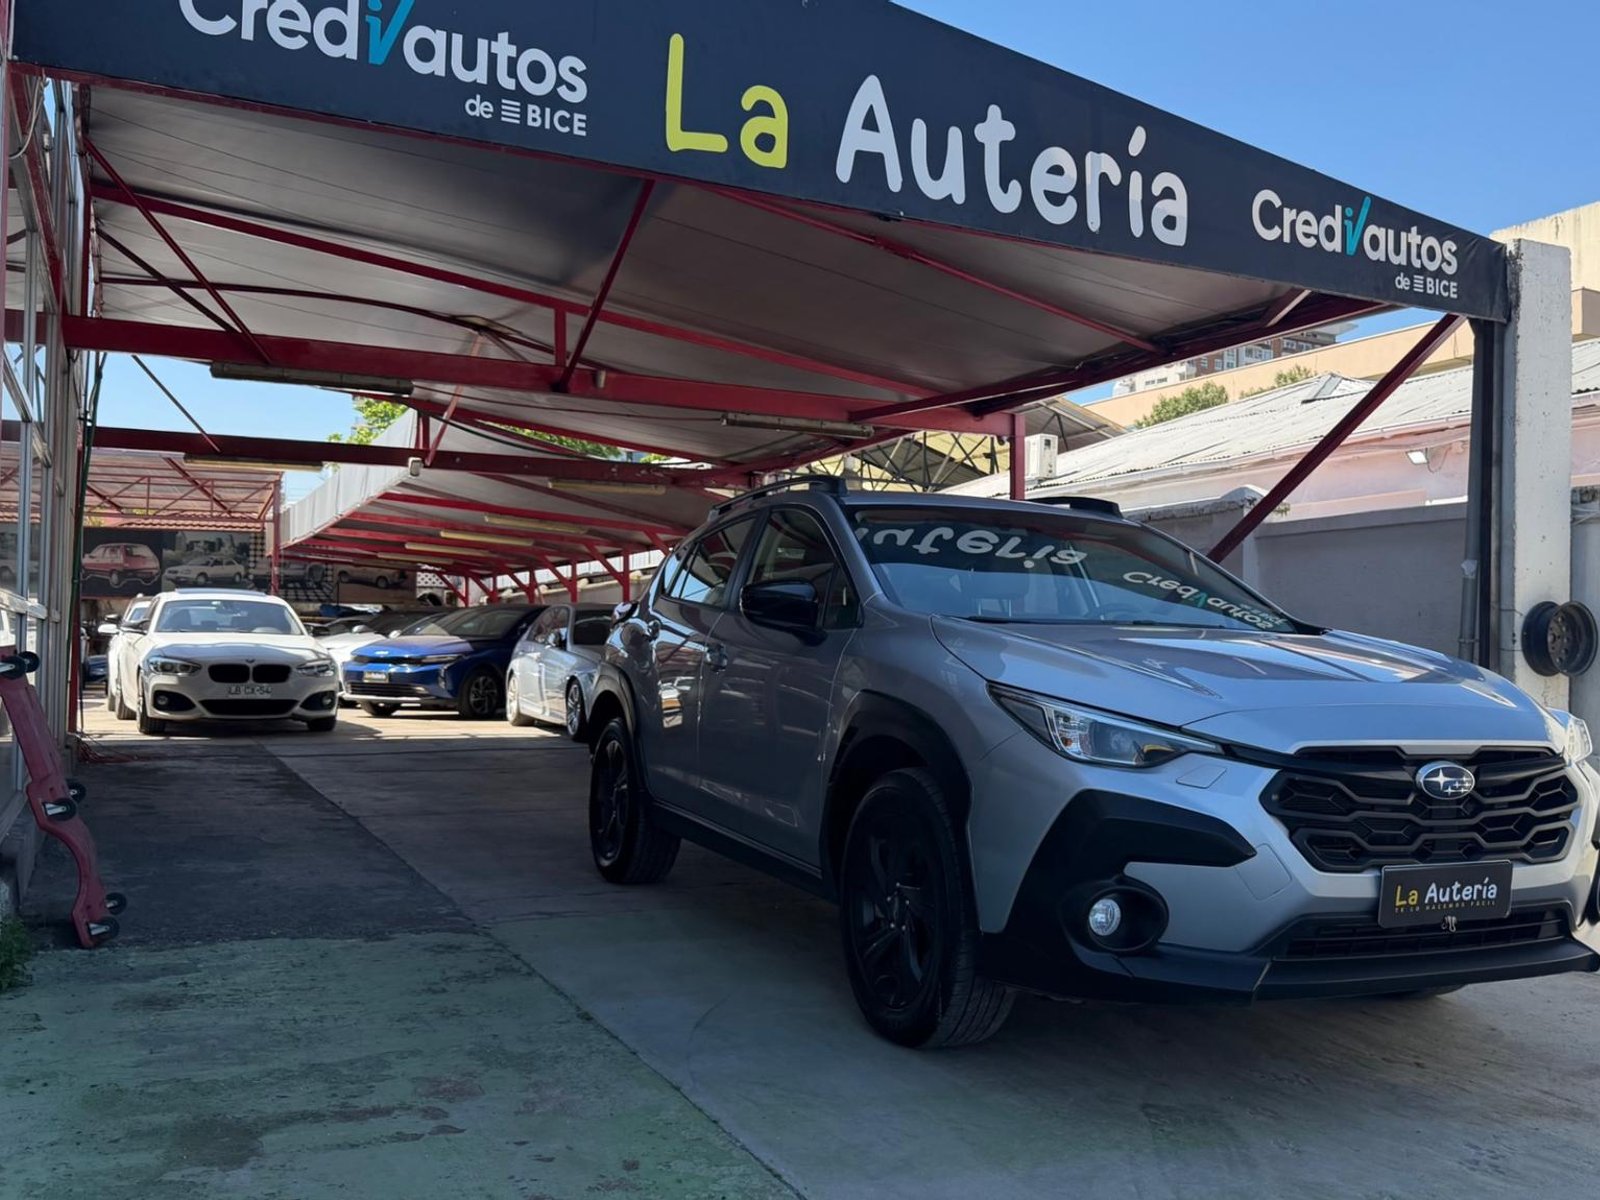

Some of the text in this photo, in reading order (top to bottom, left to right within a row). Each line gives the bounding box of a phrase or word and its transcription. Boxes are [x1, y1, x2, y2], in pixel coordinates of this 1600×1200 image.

[466, 94, 587, 136] de BICE
[666, 34, 1188, 247] La Autería
[1395, 273, 1458, 299] de BICE
[1395, 876, 1498, 907] La Autería
